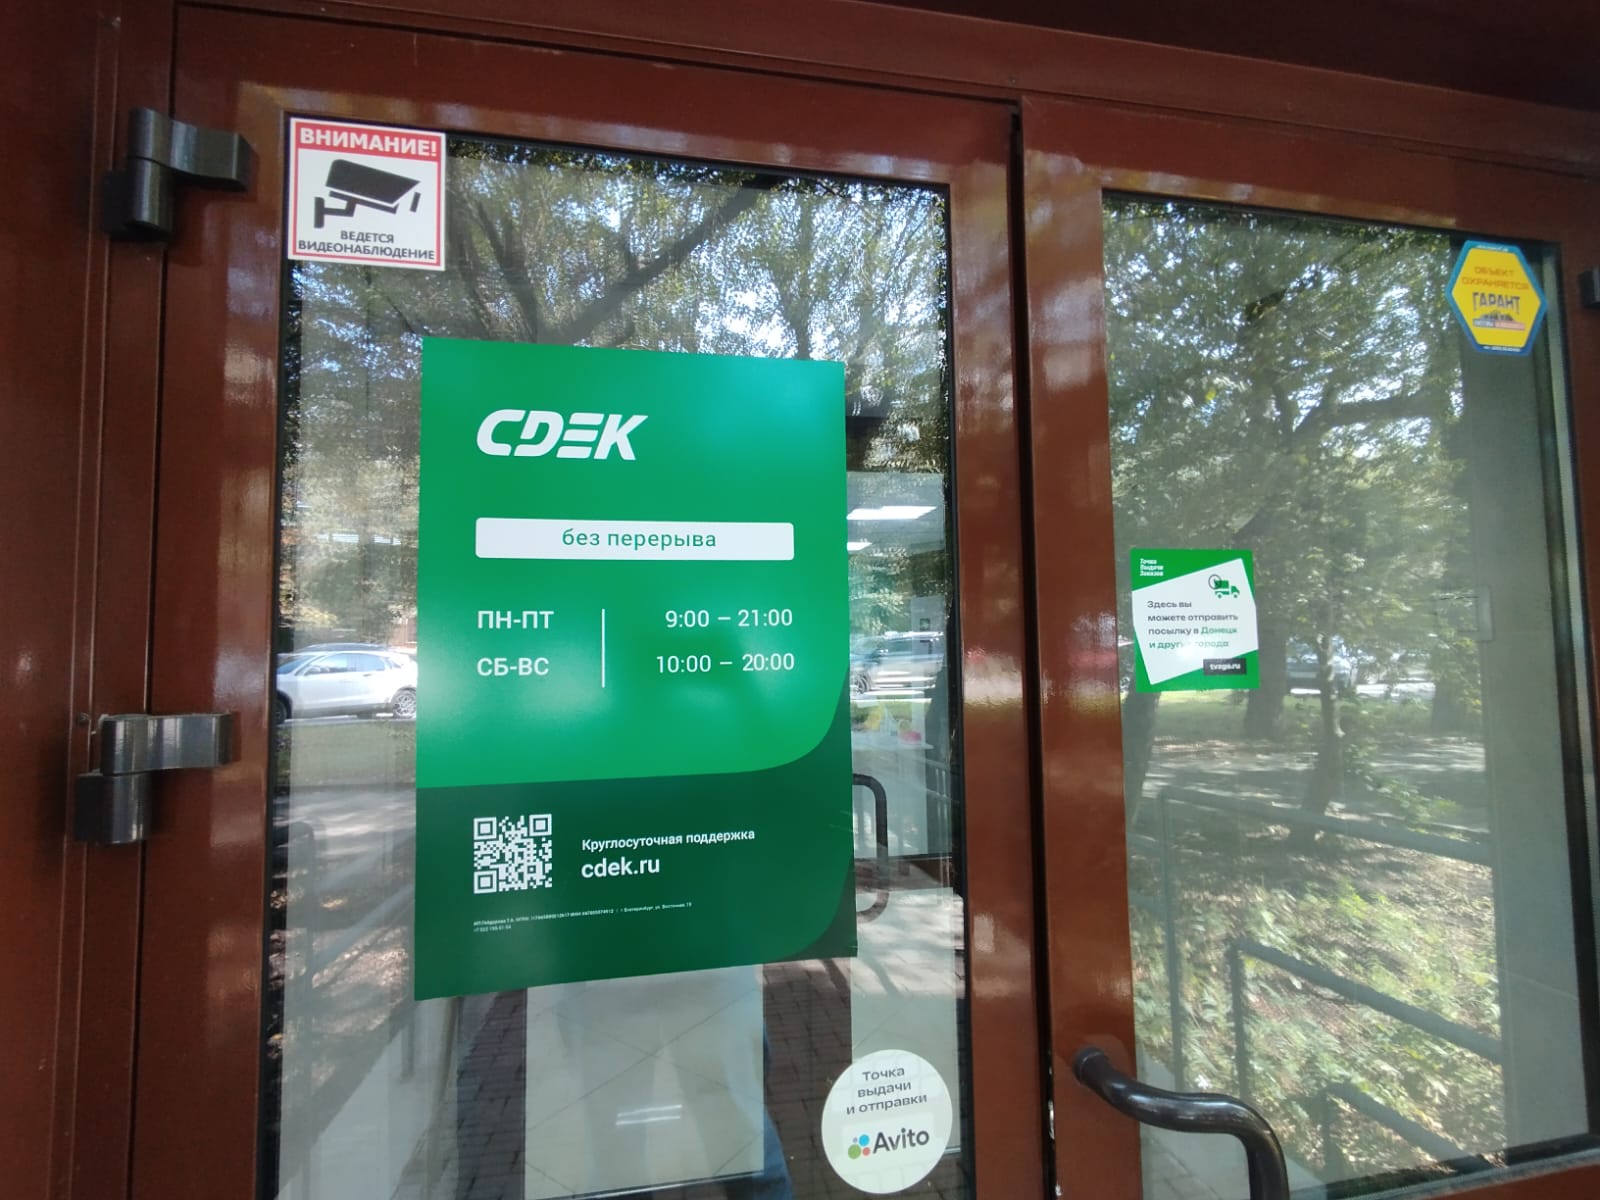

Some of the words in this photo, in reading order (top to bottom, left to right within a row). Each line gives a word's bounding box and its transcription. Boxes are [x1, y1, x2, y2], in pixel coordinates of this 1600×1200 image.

[300, 127, 438, 157] ВНИМАНИЕ!
[340, 230, 395, 244] ВЕДЕТСЯ
[298, 239, 435, 260] ВИДЕОНАБЛЮДЕНИЕ
[1472, 291, 1521, 315] ГАРАНТ
[476, 408, 649, 461] CDEK
[562, 528, 601, 546] без
[607, 530, 717, 550] перерыва
[1147, 600, 1178, 609] Здесь
[477, 610, 554, 629] ПН-ПТ
[665, 609, 710, 628] 9:00
[737, 608, 793, 627] 21:00
[1147, 614, 1186, 622] можете
[1187, 614, 1239, 622] отправить
[1148, 627, 1191, 636] посылку
[1201, 626, 1237, 634] Донецк
[477, 656, 550, 677] СБ-ВС
[656, 654, 712, 674] 10:00
[742, 652, 795, 672] 20:00
[582, 835, 683, 852] Круглосуточная
[685, 829, 756, 846] поддержка
[580, 856, 661, 879] cdek.ru
[862, 1067, 905, 1081] Точка
[857, 1081, 912, 1098] выдачи
[846, 1105, 855, 1115] и
[858, 1094, 928, 1112] отправки
[872, 1127, 930, 1155] Avito
